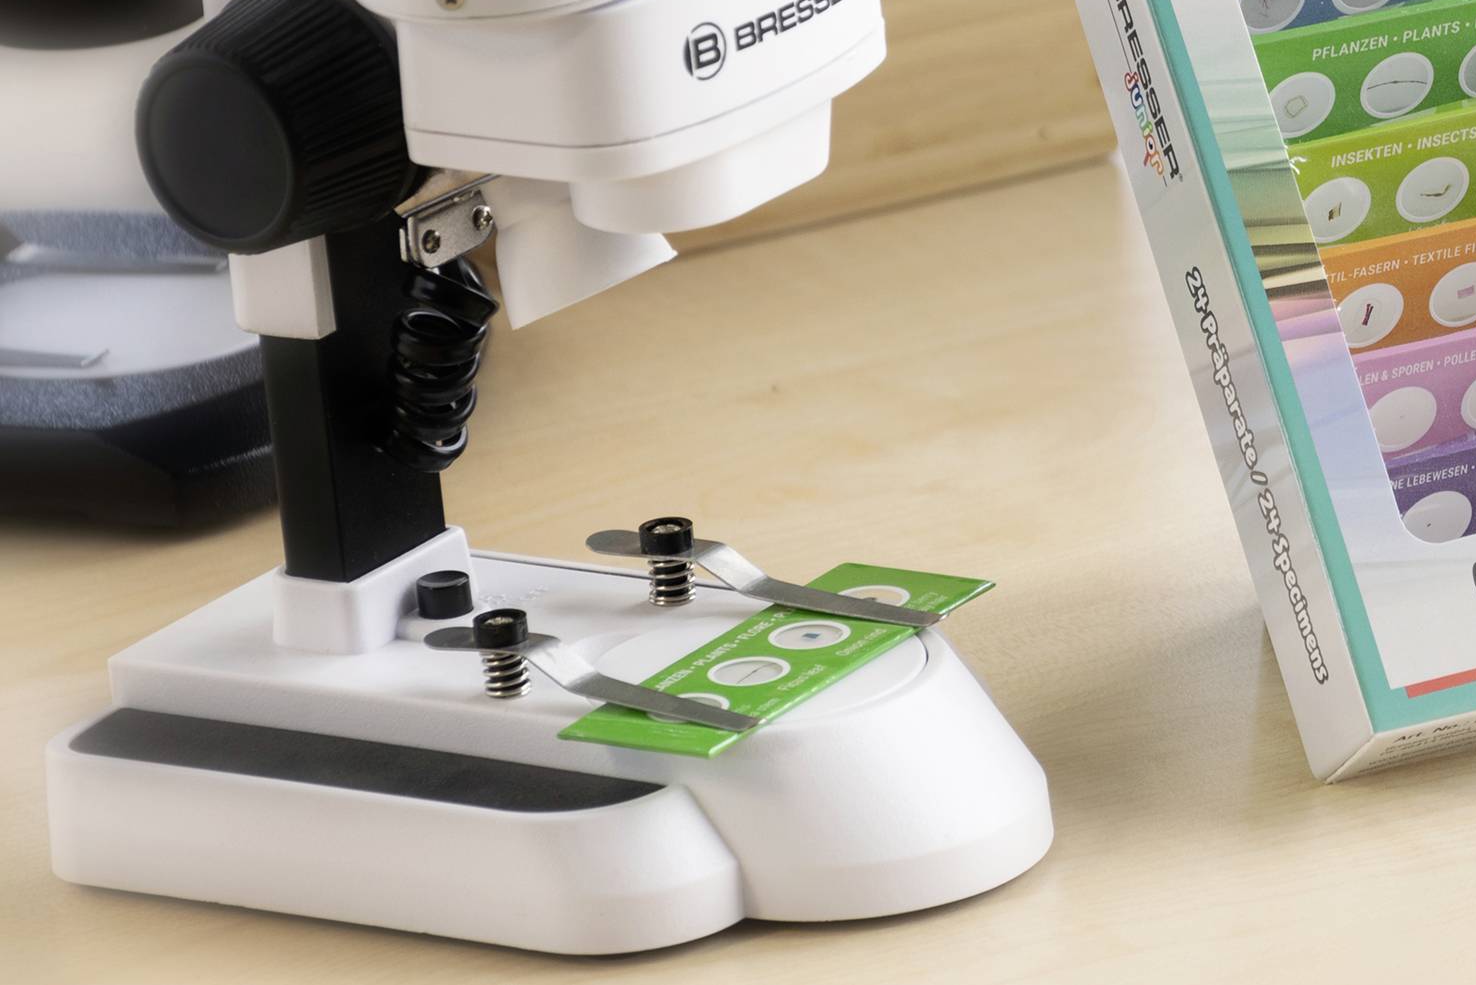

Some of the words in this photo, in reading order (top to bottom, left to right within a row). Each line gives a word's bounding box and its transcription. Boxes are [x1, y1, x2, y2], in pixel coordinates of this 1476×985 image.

[1312, 35, 1388, 61] PFLANZEN
[1402, 21, 1460, 43] PLANTS
[1331, 142, 1403, 168] INSEKTEN
[1326, 259, 1400, 284] TIL-FASERN
[1412, 245, 1461, 265] TEXTILE
[1381, 371, 1389, 382] &
[1391, 359, 1434, 379] SPOREN
[1185, 266, 1210, 315] 24
[1200, 311, 1258, 470] Präparate
[1257, 488, 1281, 535] 24
[1273, 533, 1329, 685] Specimens
[1406, 464, 1469, 488] LEBEWESEN
